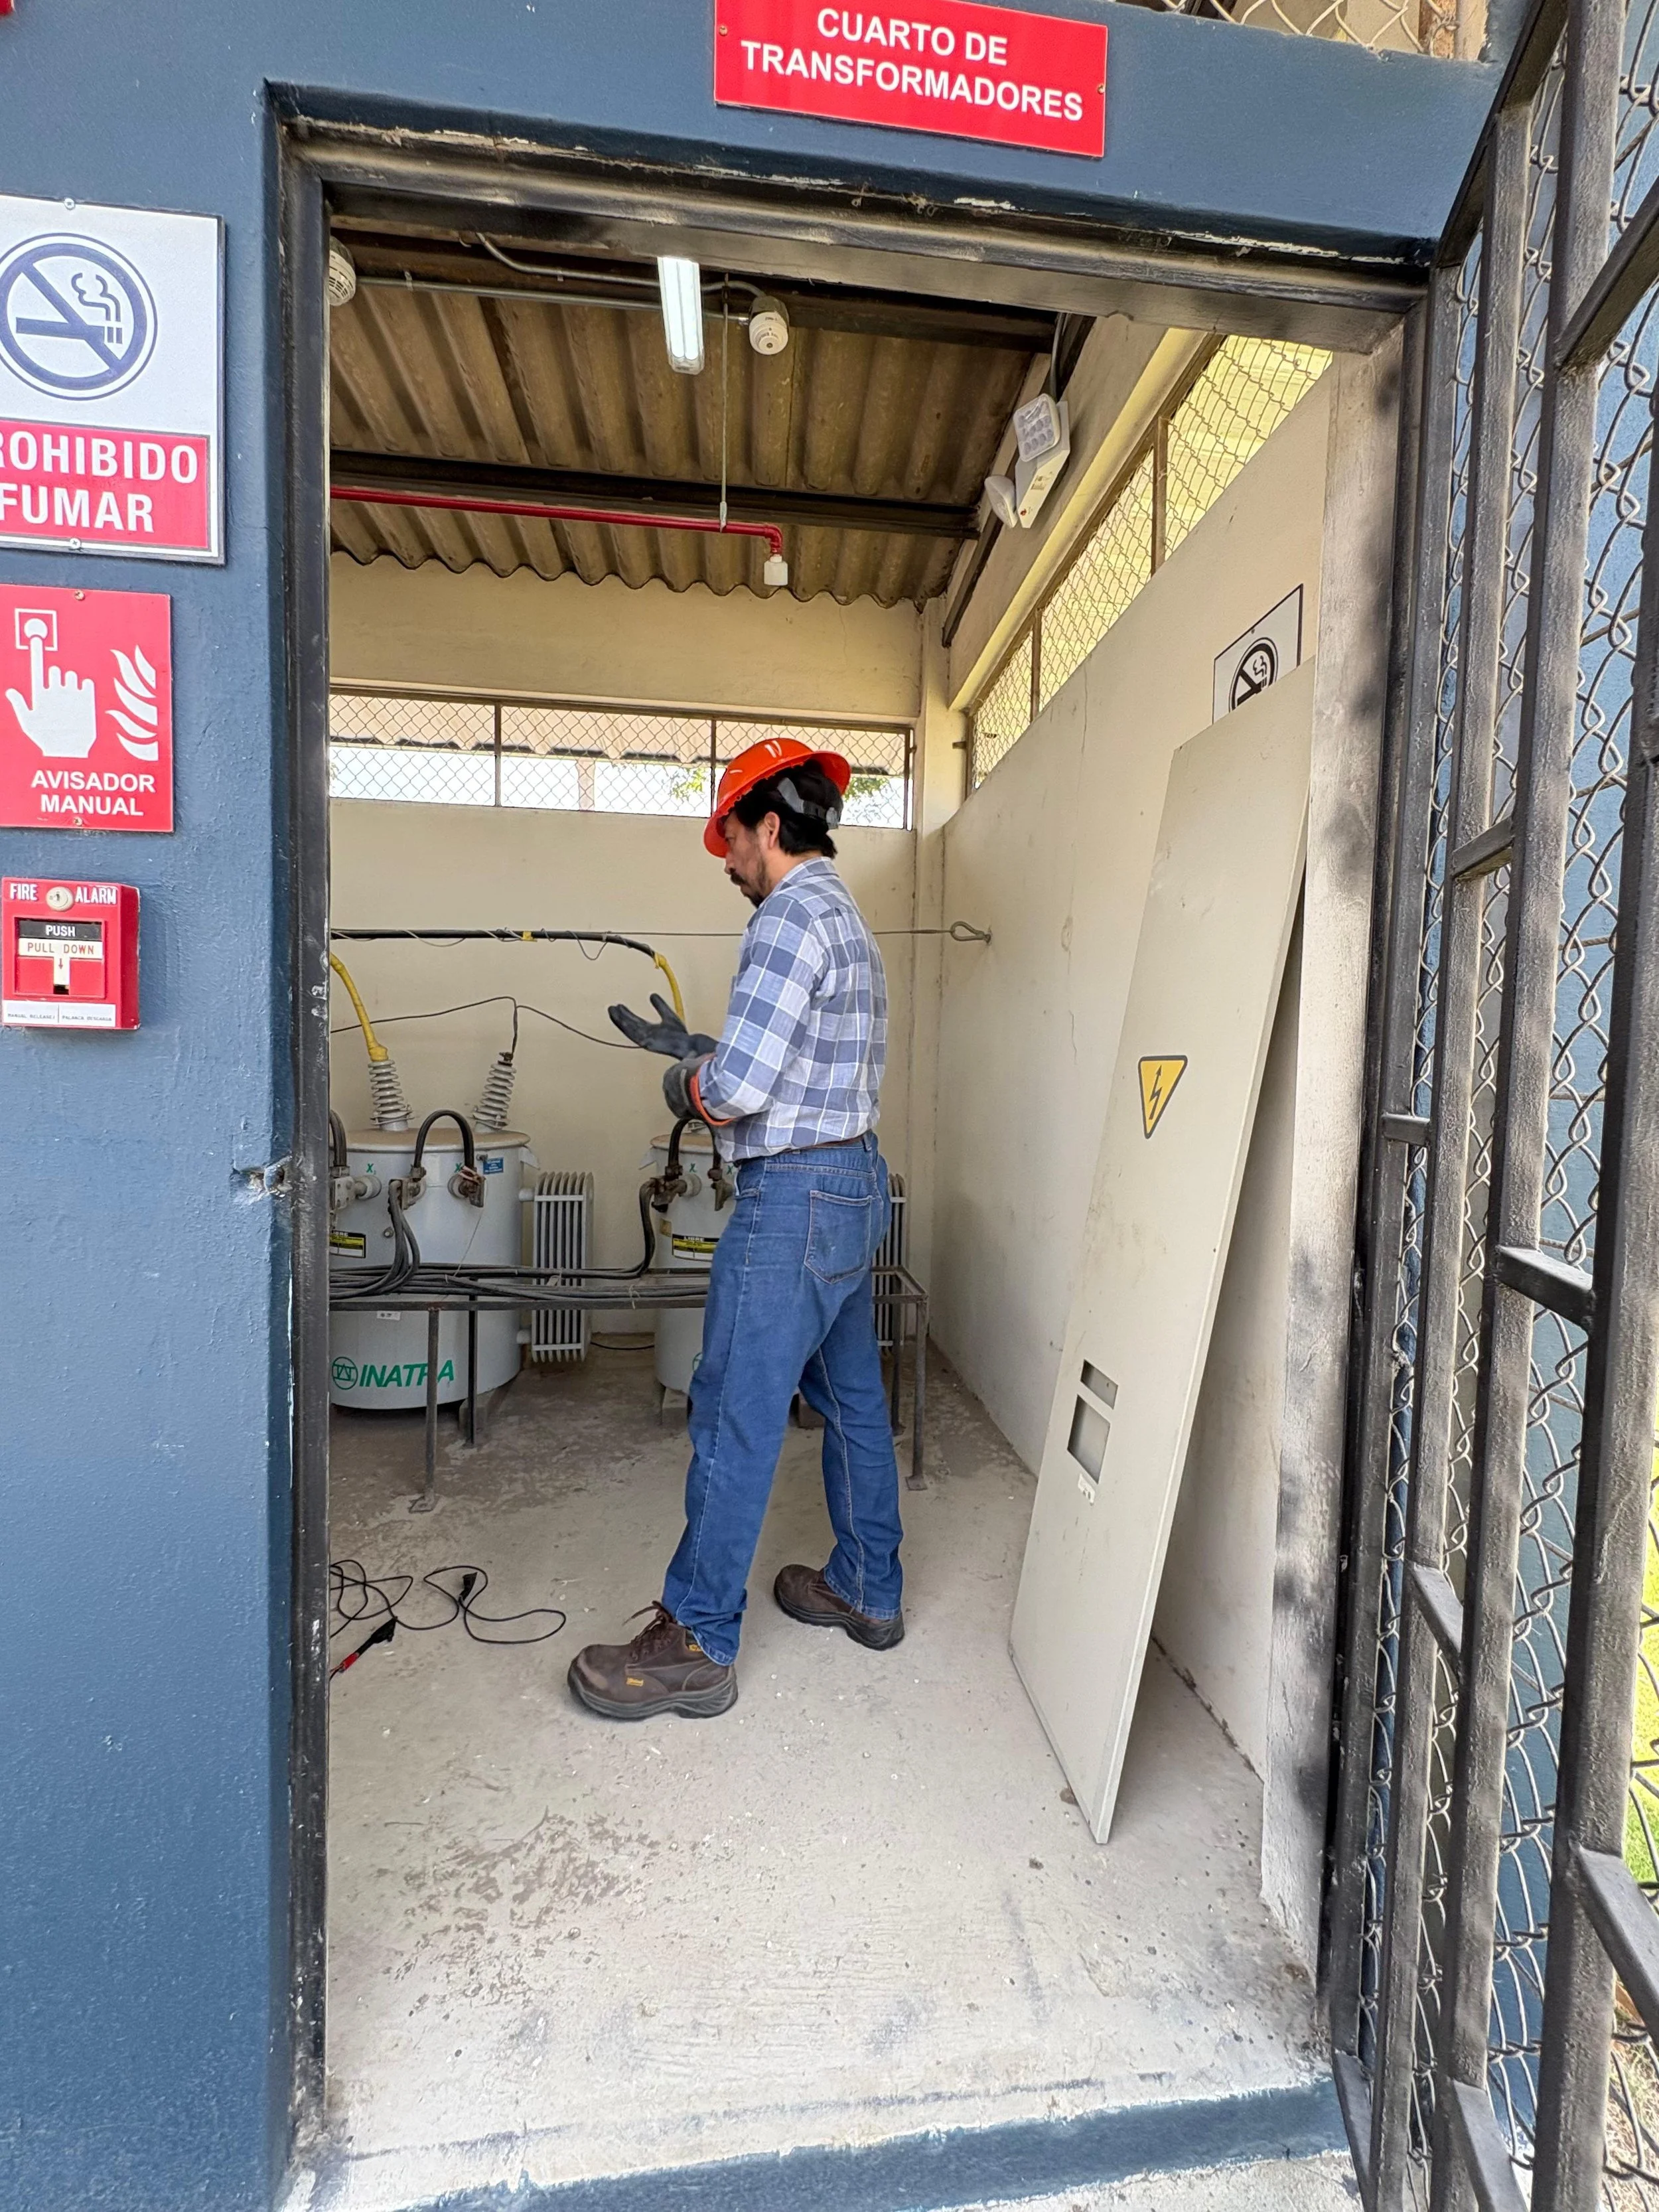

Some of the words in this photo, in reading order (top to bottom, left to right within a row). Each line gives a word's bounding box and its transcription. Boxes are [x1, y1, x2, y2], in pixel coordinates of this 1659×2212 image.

[818, 8, 956, 56] CUARTO
[966, 32, 1008, 66] DE
[741, 40, 1083, 121] TRANSFORMADORES
[0, 431, 198, 483] OHIBIDO
[0, 482, 154, 532] FUMAR
[31, 770, 155, 792] AVISADOR
[40, 794, 143, 816] MANUAL
[10, 884, 37, 900] FIRE
[75, 887, 117, 905] ALARM
[45, 924, 76, 937] PUSH
[27, 942, 54, 953] PULL
[63, 944, 94, 954] DOWN
